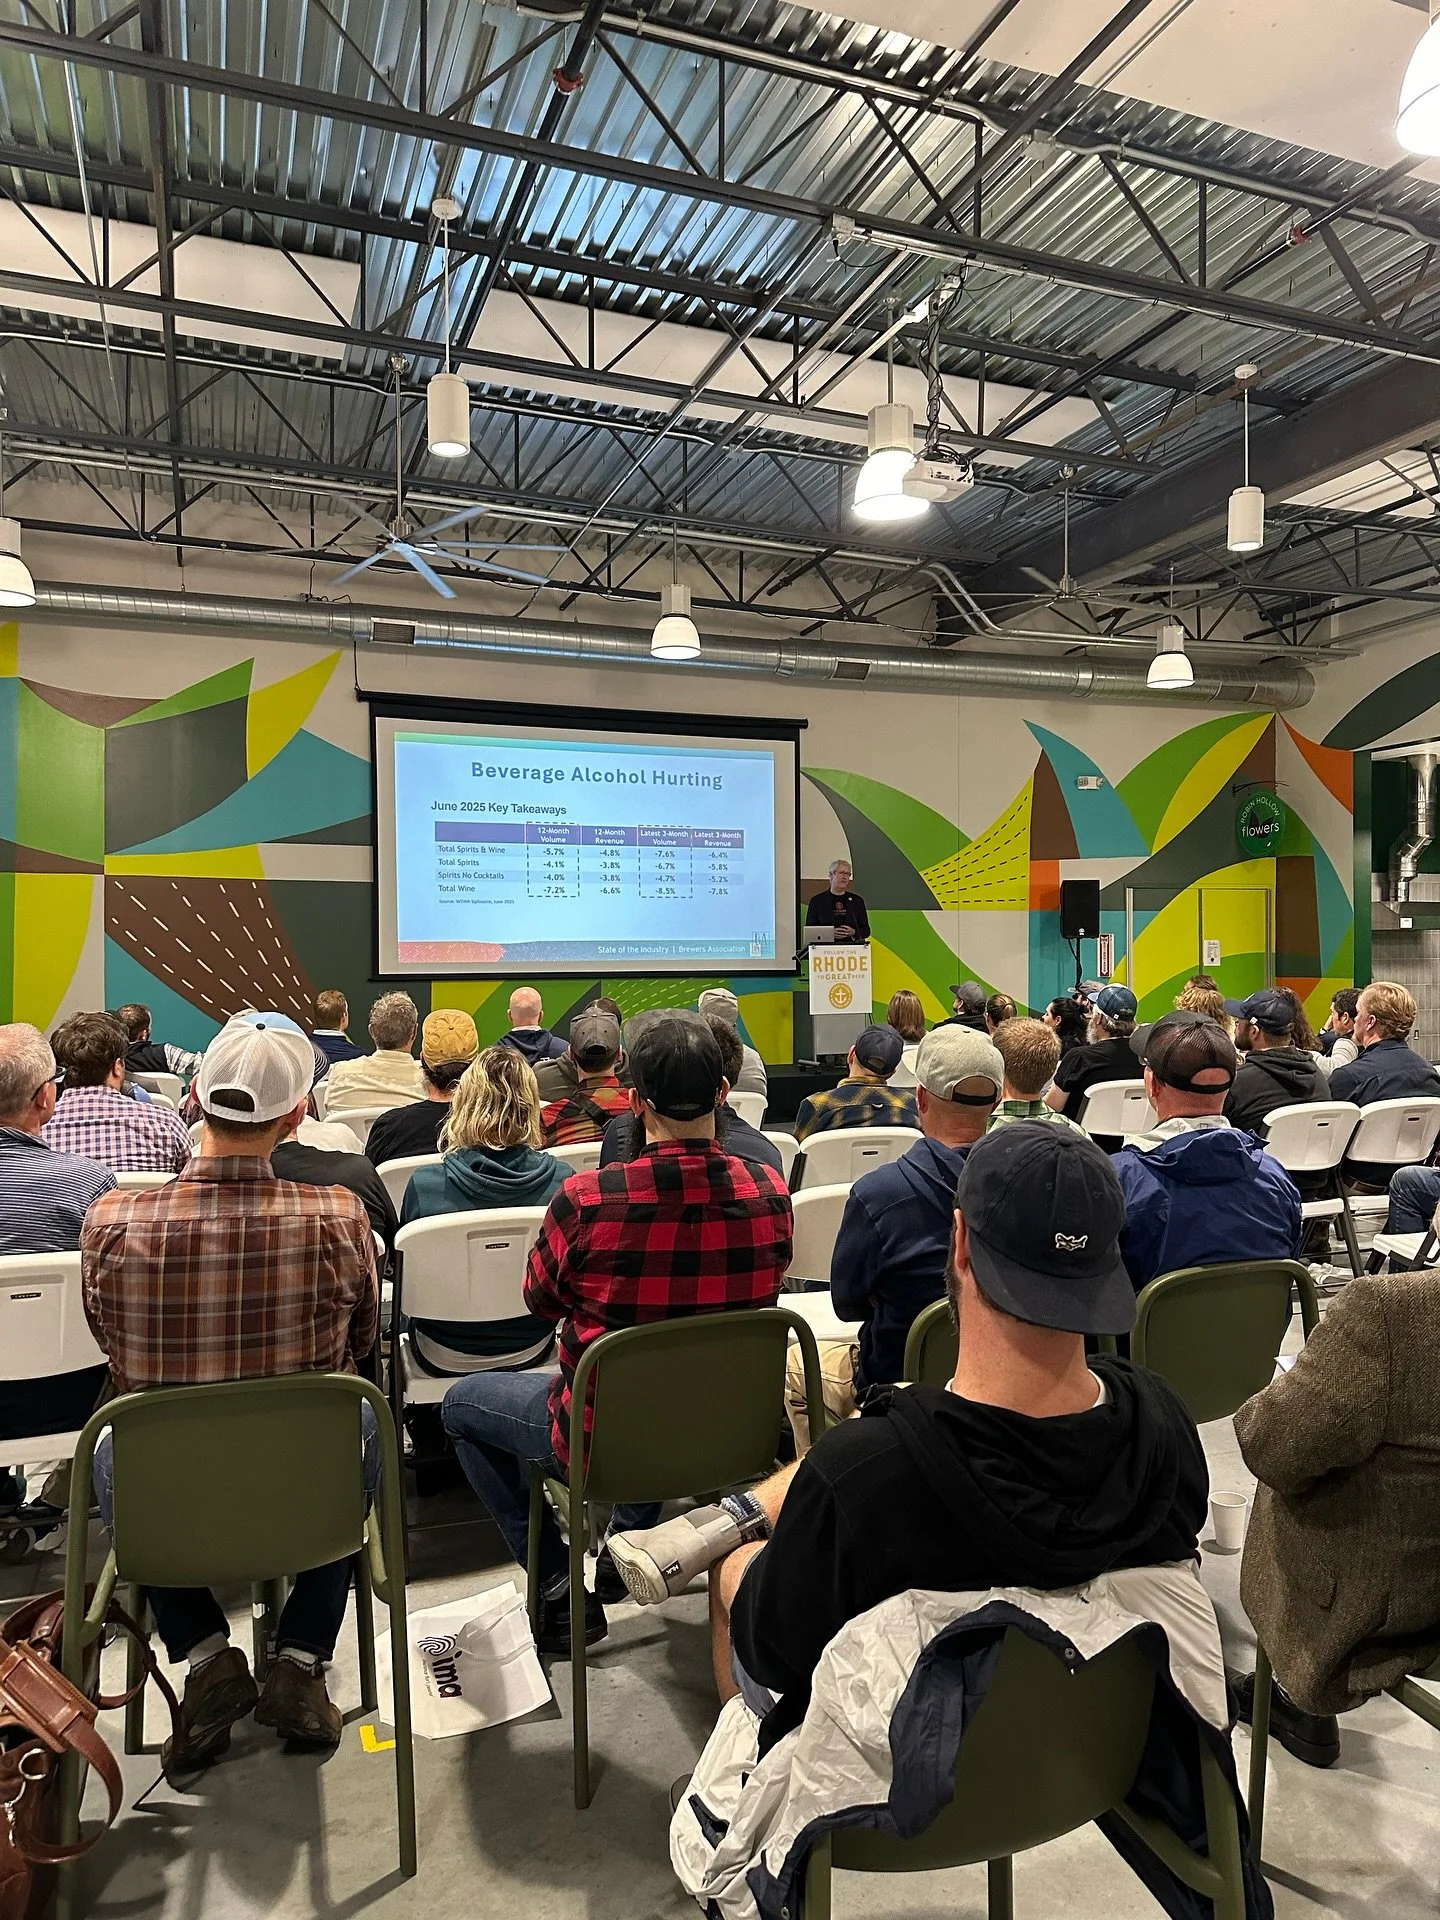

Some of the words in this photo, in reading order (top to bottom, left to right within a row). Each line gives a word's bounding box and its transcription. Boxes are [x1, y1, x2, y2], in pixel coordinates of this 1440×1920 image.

[471, 762, 565, 784] Beverage
[571, 766, 647, 785] Alcohol
[652, 770, 723, 790] Hurting
[431, 801, 458, 811] June
[460, 801, 486, 812] 2025
[488, 802, 508, 815] Key
[510, 803, 567, 816] Takeaways
[1241, 800, 1255, 823] ROBIN
[1256, 796, 1280, 816] HOLLOW
[537, 826, 570, 835] 12-Month
[594, 828, 626, 837] 12-Month
[640, 829, 661, 837] Latest
[662, 829, 689, 838] 3-Month
[1241, 822, 1280, 838] flowers
[540, 835, 567, 843] Volume
[694, 831, 714, 839] Latest
[715, 831, 742, 839] 3-Month
[595, 837, 625, 845] Revenue
[652, 838, 677, 846] Volume
[704, 839, 732, 847] Revenue
[438, 845, 456, 853] Total
[457, 845, 479, 854] Spirits
[488, 846, 506, 854] Wine
[543, 848, 565, 856] -5.7%
[599, 849, 621, 857] -4.8%
[655, 850, 676, 858] -7.6%
[708, 851, 729, 859] -6.4%
[438, 858, 456, 866] Total
[457, 858, 480, 867] Spirits
[599, 861, 621, 869] -3.8%
[655, 862, 676, 870] -6.7%
[708, 863, 729, 871] -5.8%
[438, 871, 461, 880] Spirits
[473, 872, 505, 880] Cocktails
[543, 873, 565, 881] -4.0%
[599, 874, 621, 882] -3.8%
[438, 884, 456, 892] Total
[543, 886, 565, 894] -7.2%
[599, 887, 621, 895] -6.6%
[655, 887, 676, 895] -8.5%
[708, 888, 729, 896] -7.8%
[597, 945, 617, 954] State
[618, 945, 626, 954] of
[627, 945, 638, 953] the
[640, 945, 669, 955] Industry
[678, 945, 706, 953] Brewers
[707, 945, 746, 953] Association
[813, 956, 868, 972] RHODE
[432, 1650, 463, 1698] ima
